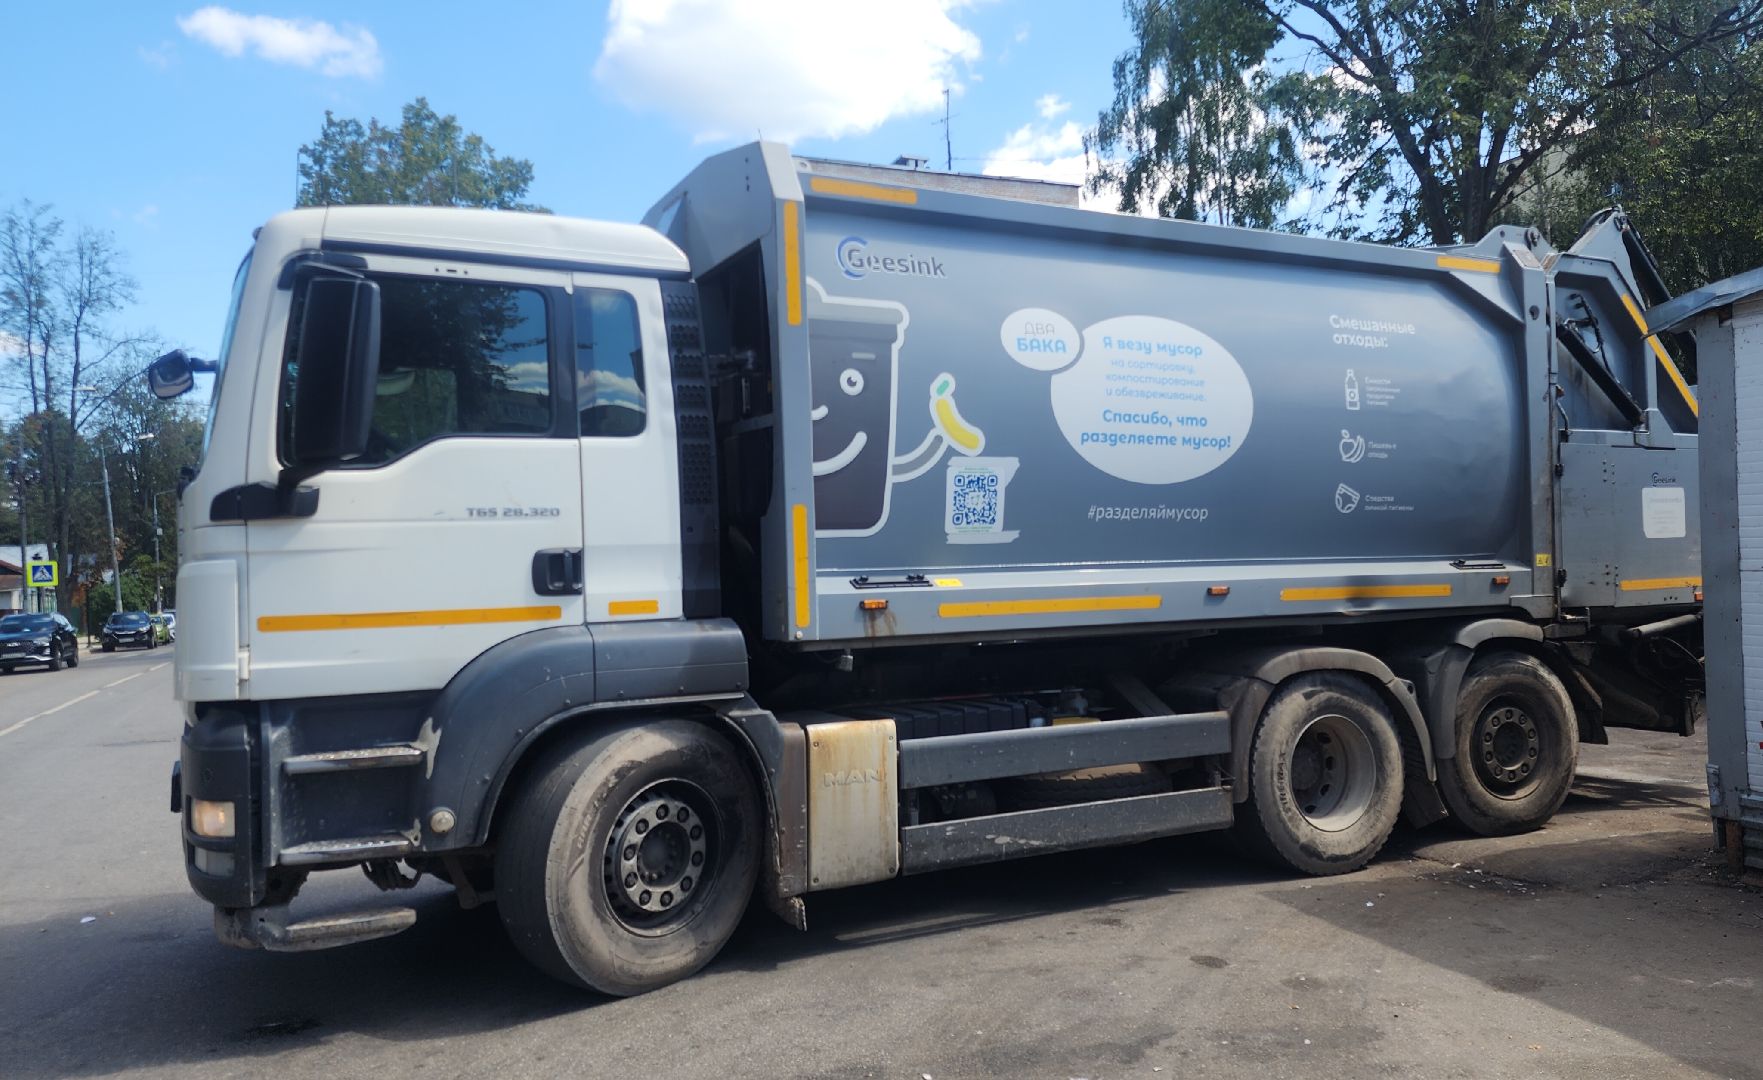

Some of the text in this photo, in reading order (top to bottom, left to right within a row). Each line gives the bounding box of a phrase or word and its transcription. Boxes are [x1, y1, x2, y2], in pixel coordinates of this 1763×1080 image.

[842, 243, 947, 278] Geesink
[1024, 321, 1056, 336] ДВА
[1329, 314, 1416, 334] Смешанные
[1016, 337, 1068, 353] БАКА
[1102, 336, 1204, 357] Я везу мусор
[1332, 333, 1389, 348] отходы:
[1111, 359, 1125, 368] на
[1105, 373, 1205, 387] компостирование
[1105, 388, 1113, 396] и
[1102, 409, 1208, 428] Спасибо, что
[1080, 431, 1232, 450] разделяете мусор!
[503, 507, 561, 518] 28.320
[1087, 504, 1209, 522] #разделяймусор
[823, 769, 886, 788] MAN
